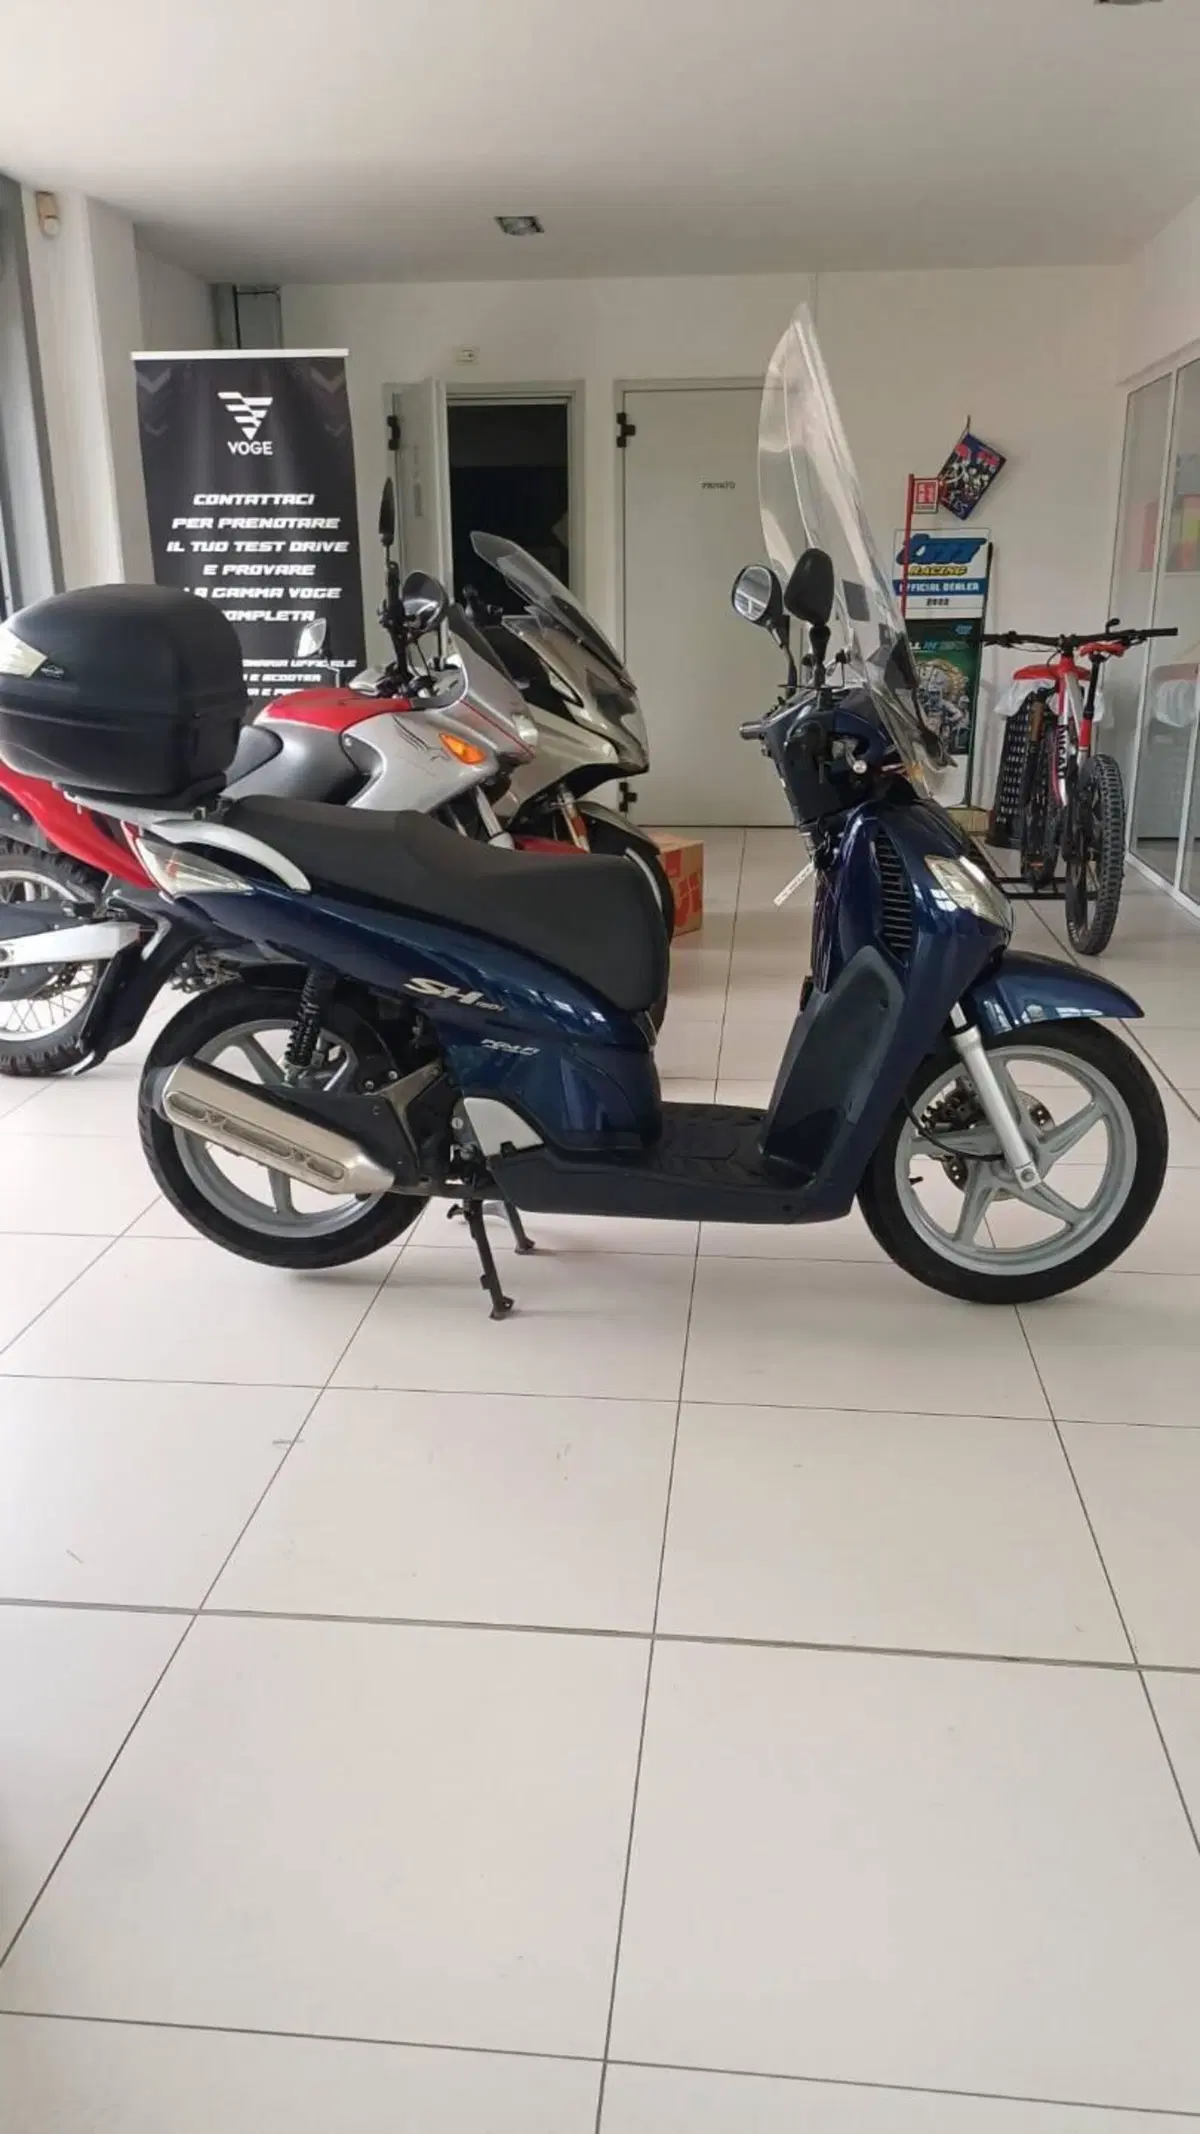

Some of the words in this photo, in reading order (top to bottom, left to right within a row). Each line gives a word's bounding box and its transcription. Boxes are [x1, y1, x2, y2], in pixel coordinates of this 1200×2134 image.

[227, 440, 274, 456] VOGE
[193, 493, 316, 506] CONTATTACI
[171, 517, 215, 530] PER
[217, 517, 341, 530] PRENOTARE
[166, 540, 186, 553] IL
[190, 540, 230, 553] TUO
[233, 540, 287, 553] TEST
[288, 540, 350, 553] DRIVE
[202, 563, 219, 576] E
[221, 563, 317, 576] PROVARE
[183, 587, 209, 599] A
[211, 587, 285, 599] GAMMA
[288, 587, 343, 599] VOGE
[943, 581, 980, 592] DEALER
[222, 610, 316, 622] OMPLETA
[262, 673, 322, 682] SCOOTER
[402, 977, 484, 1005] SH
